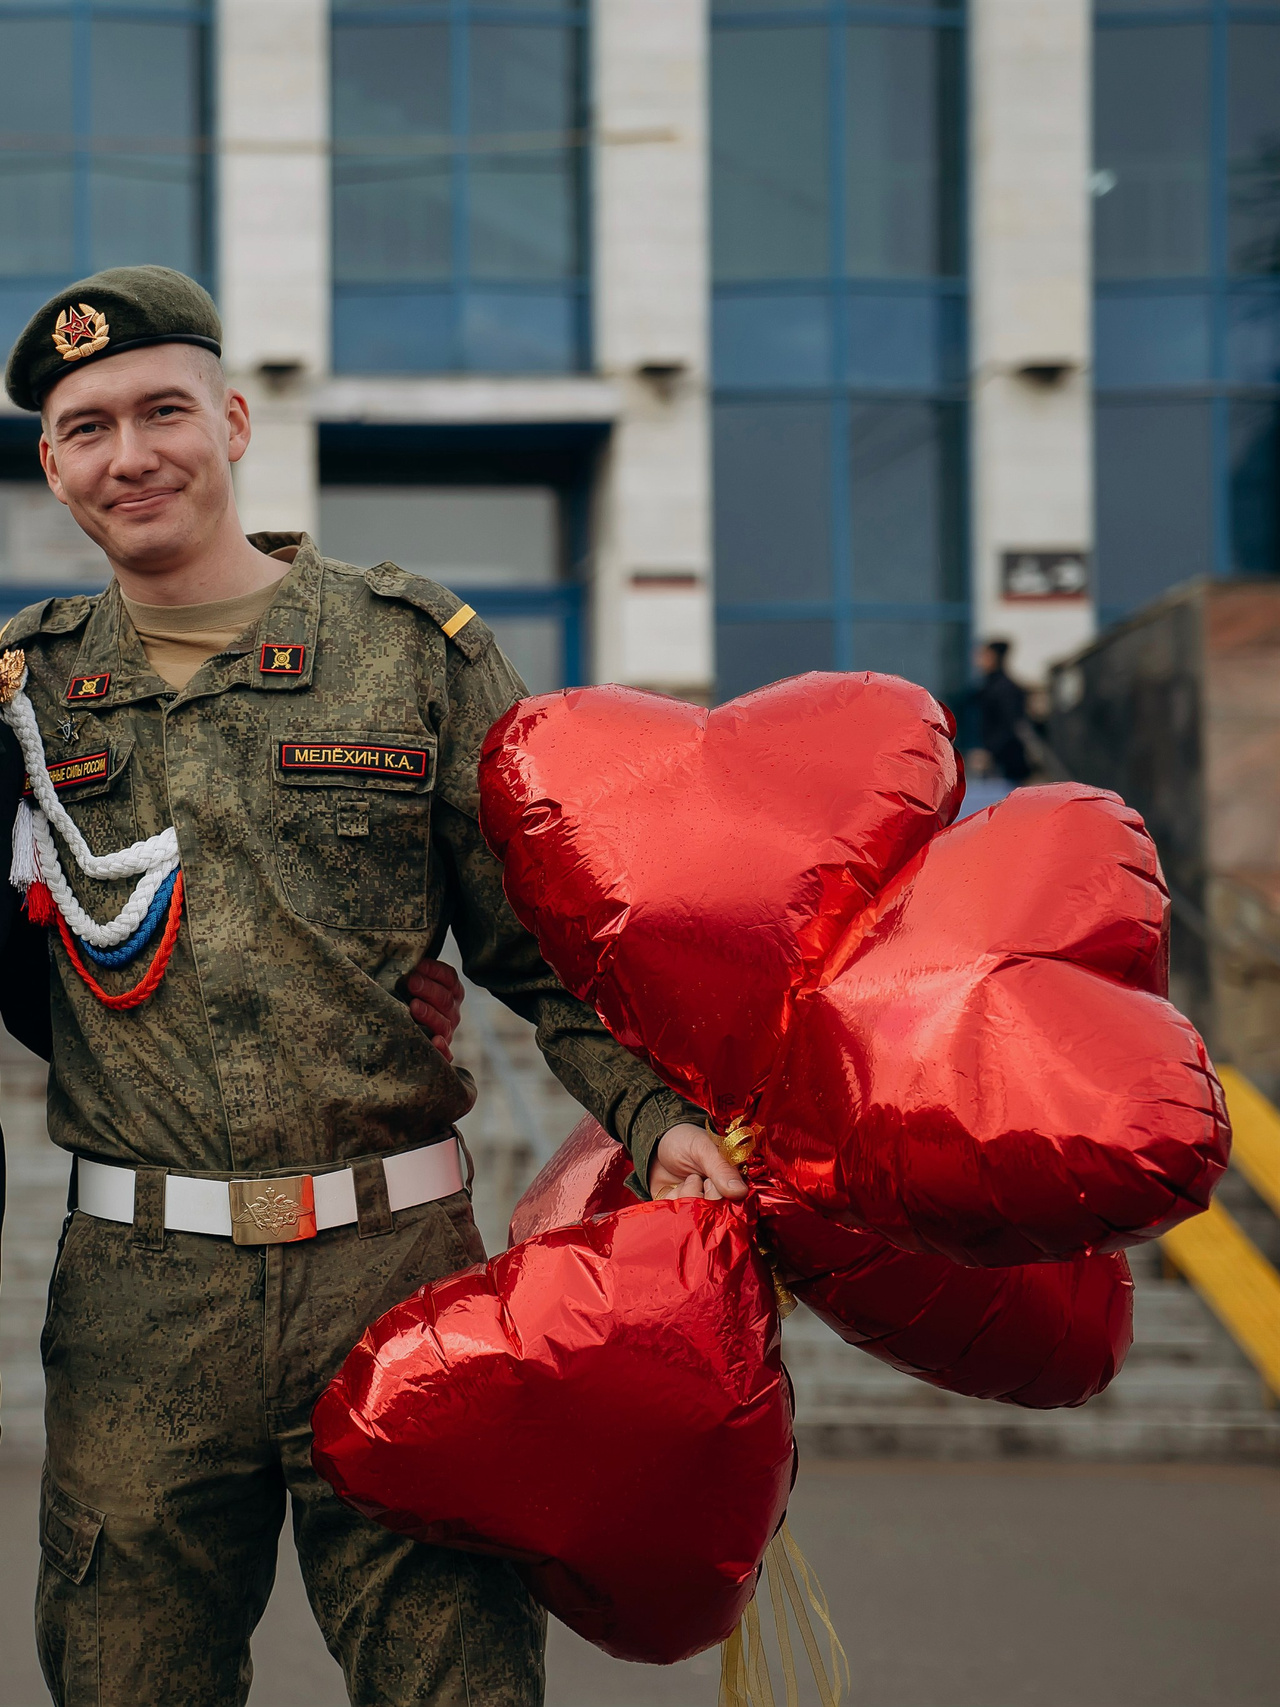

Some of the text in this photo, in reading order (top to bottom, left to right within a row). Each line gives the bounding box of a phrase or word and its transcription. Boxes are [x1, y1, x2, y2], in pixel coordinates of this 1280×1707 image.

[66, 764, 83, 779] СИЛЫ
[83, 757, 106, 776] РОССИИ
[294, 748, 415, 771] МЕЛЁХИН К.А.
